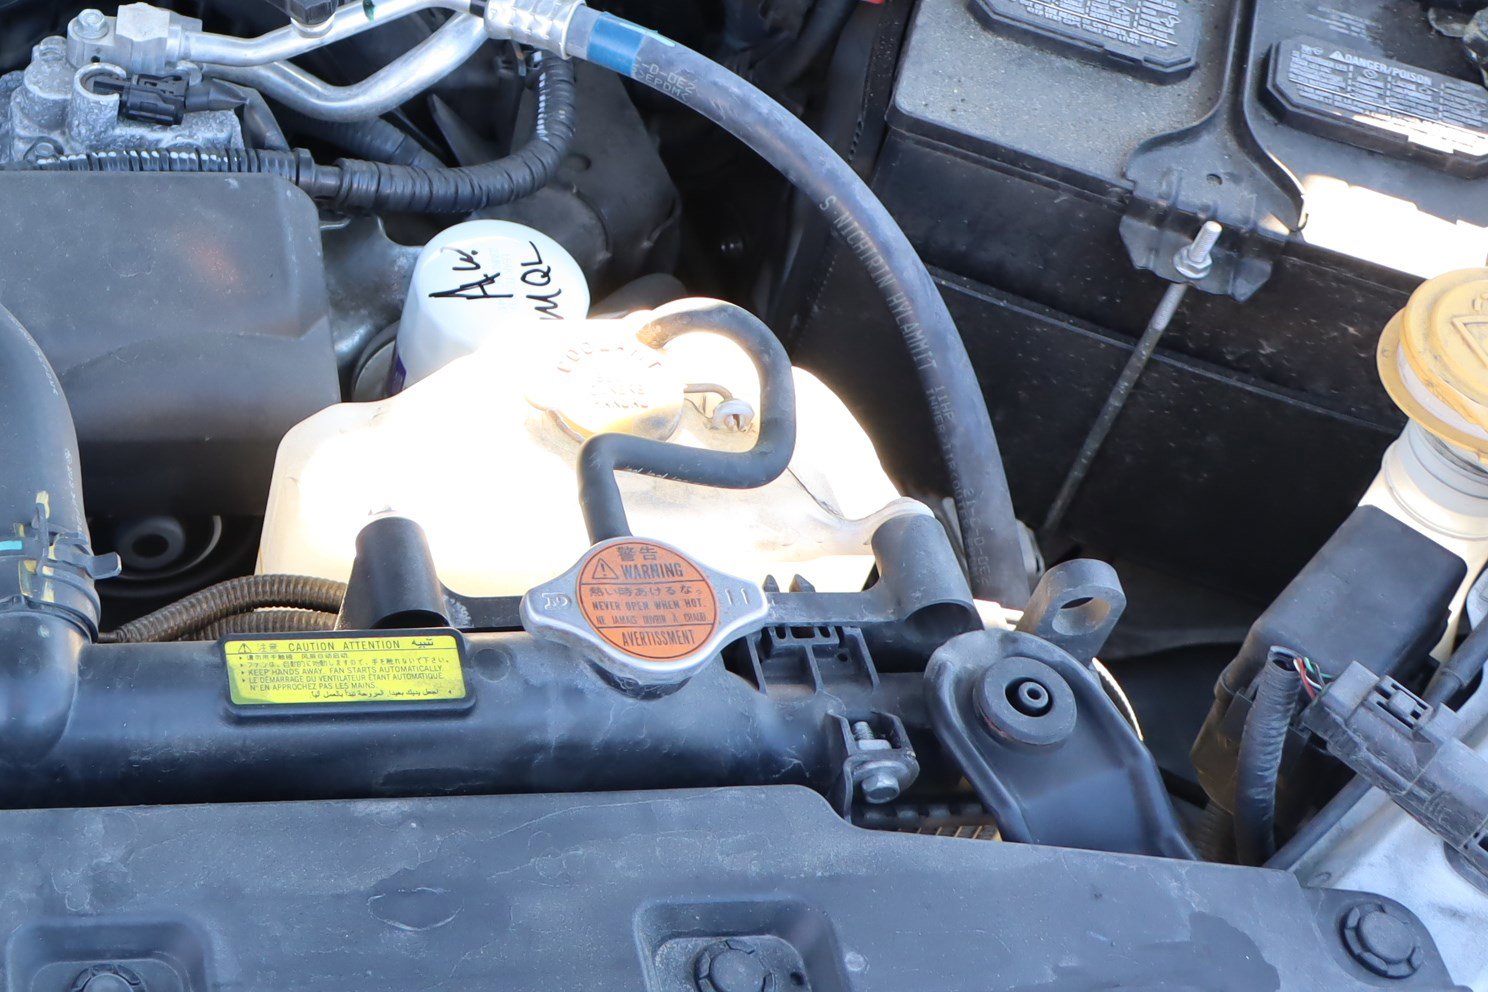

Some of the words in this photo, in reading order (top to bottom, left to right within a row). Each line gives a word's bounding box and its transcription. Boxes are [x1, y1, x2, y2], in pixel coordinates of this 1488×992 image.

[616, 545, 658, 562] 警告
[620, 562, 684, 580] WARNING
[592, 601, 620, 611] NEVER
[625, 601, 649, 610] OPEN
[653, 599, 680, 609] WHEN
[595, 616, 607, 625] NE
[612, 615, 638, 625] JAMAIS
[621, 629, 695, 647] AVERTISSMENT
[257, 642, 279, 653] 注意
[288, 642, 335, 652] CAUTION
[343, 640, 400, 650] ATTENTION
[347, 666, 377, 674] STARTS
[319, 673, 366, 682] VENTILATEUR
